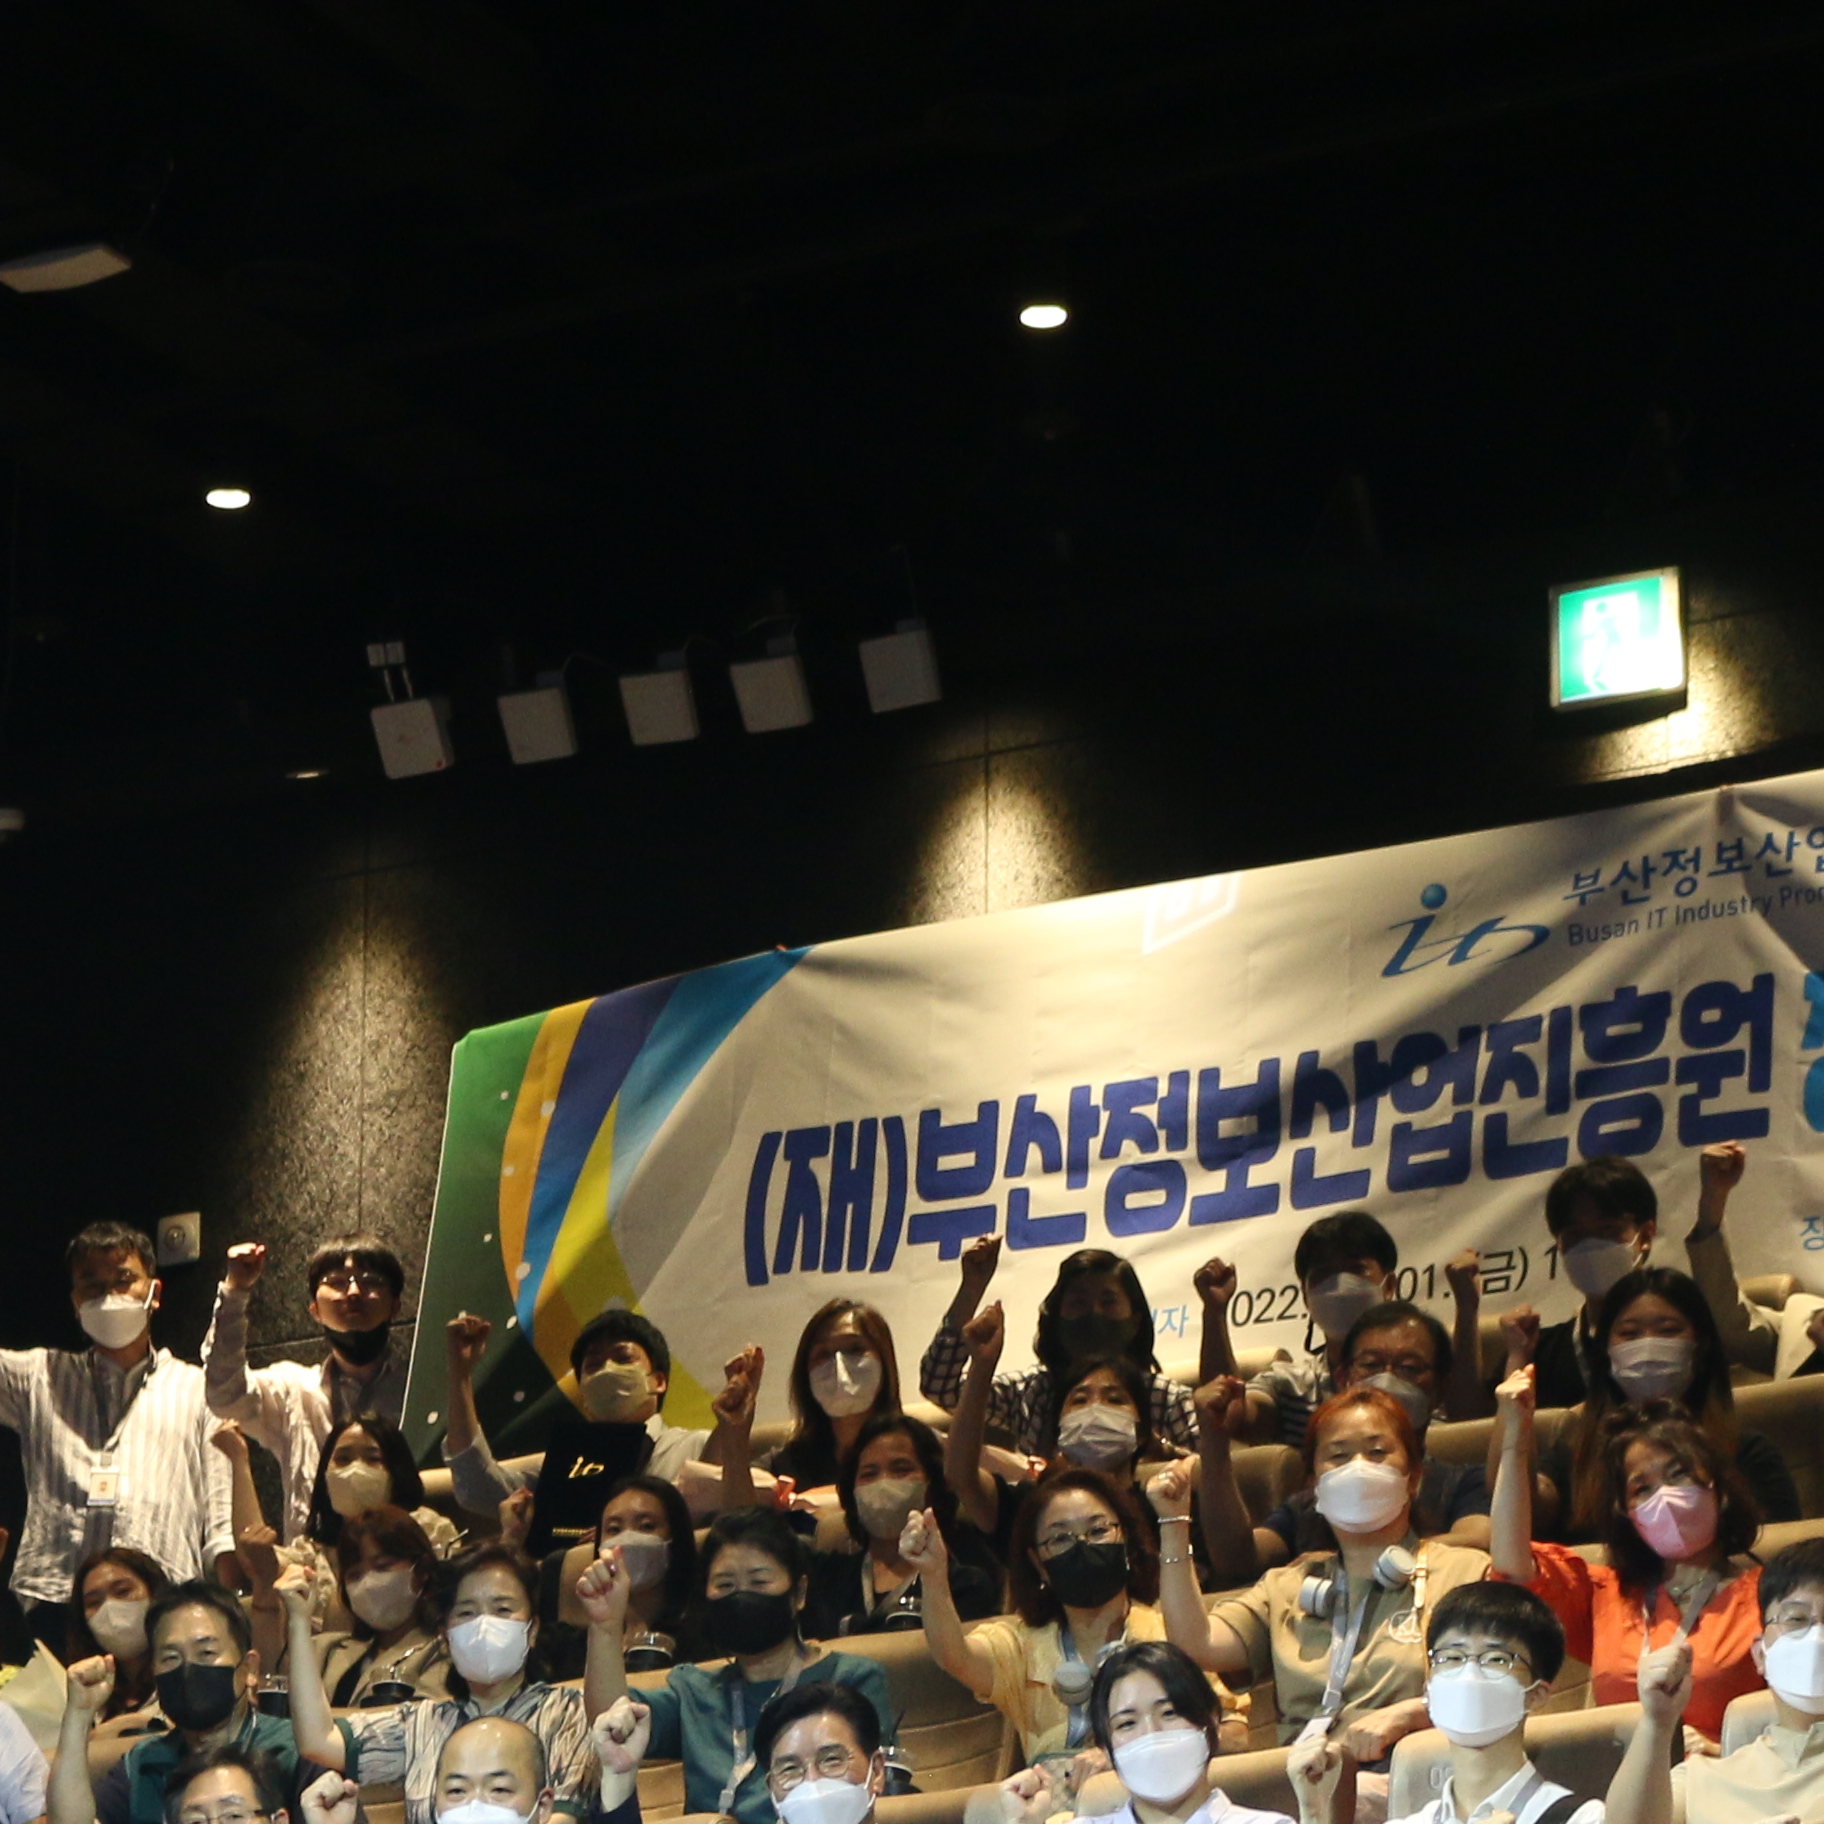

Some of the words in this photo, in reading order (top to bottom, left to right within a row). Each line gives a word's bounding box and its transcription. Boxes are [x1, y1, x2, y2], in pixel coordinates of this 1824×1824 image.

[1567, 917, 1640, 947] Busan
[1647, 906, 1669, 930] IT
[1675, 890, 1773, 927] Industry
[744, 972, 1775, 1287] (재)부산정보산업진흥원
[1152, 1304, 1189, 1338] 자
[1231, 1285, 1309, 1328] 022.
